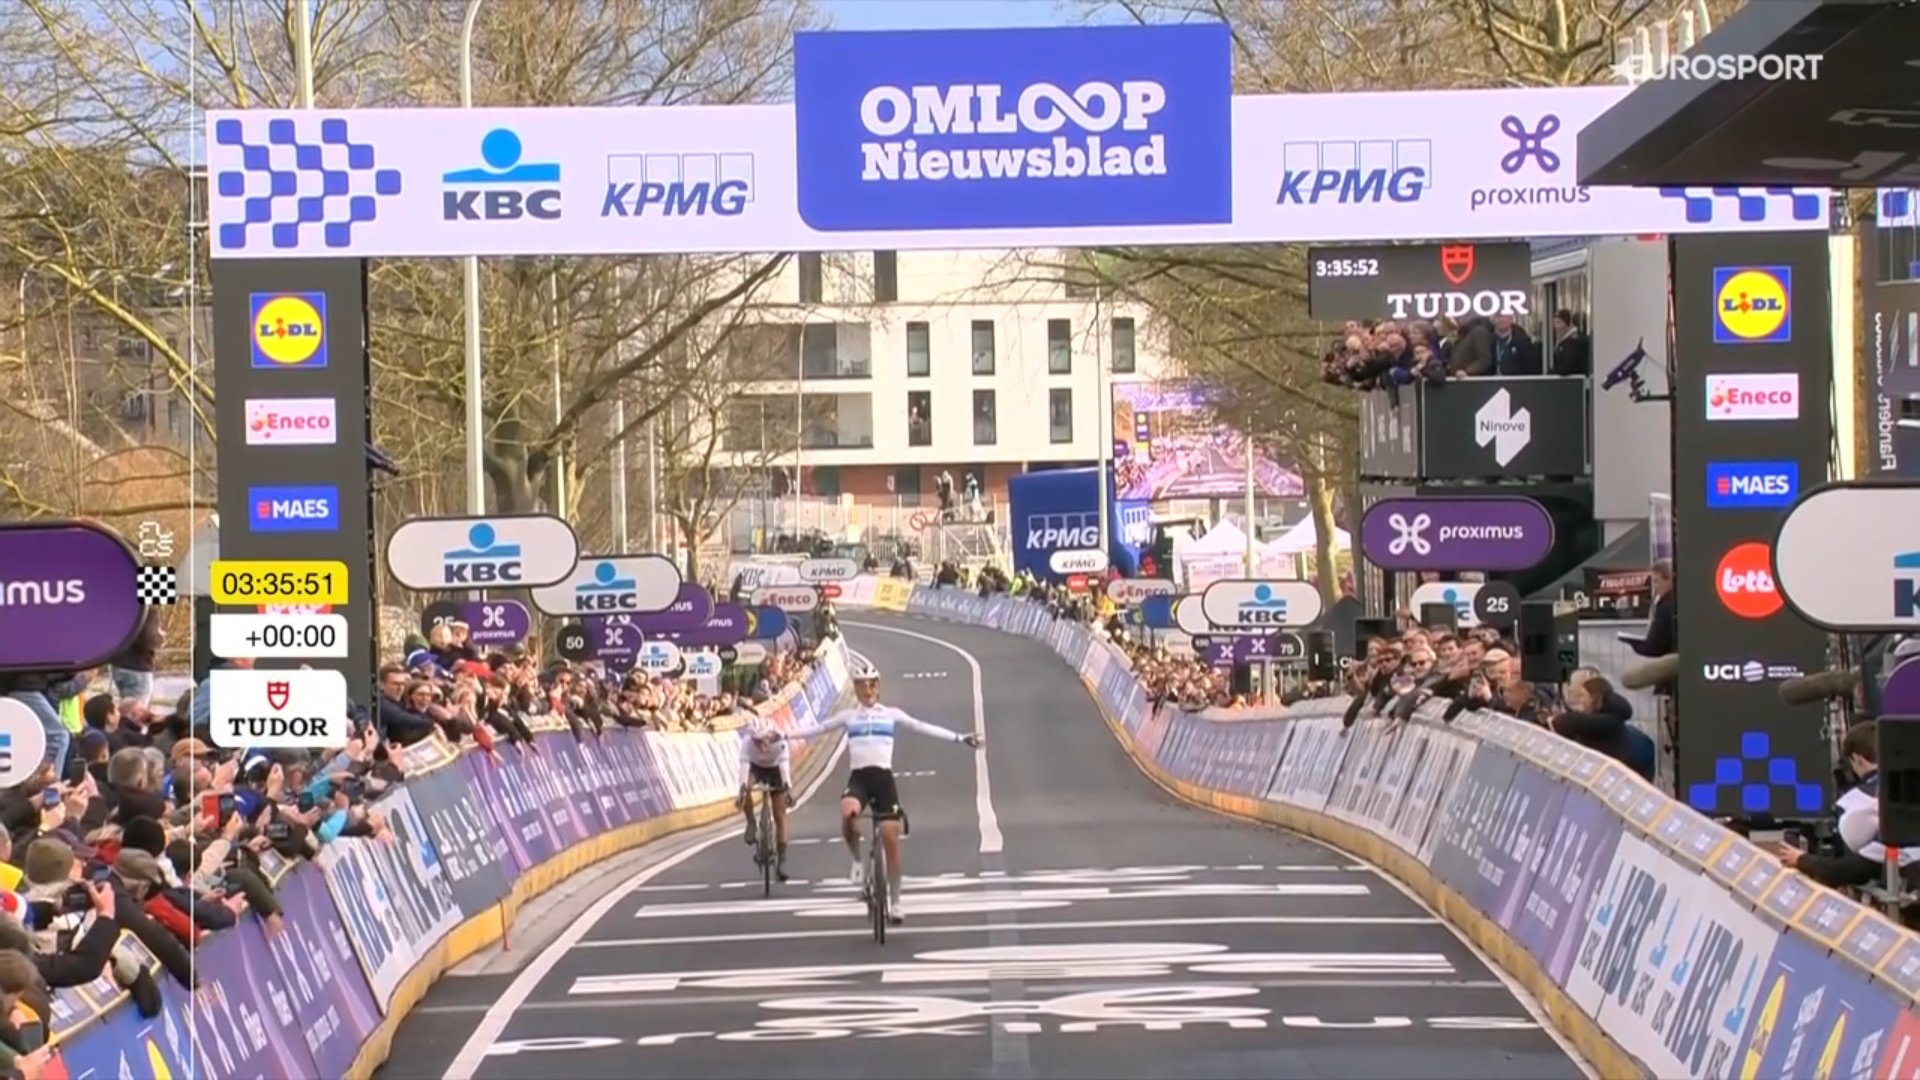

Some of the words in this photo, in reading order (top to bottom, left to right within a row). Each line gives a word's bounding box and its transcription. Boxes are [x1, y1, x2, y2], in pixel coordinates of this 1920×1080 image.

[860, 81, 1167, 136] OMLOOP
[861, 134, 1167, 181] Nieuwsblad
[1276, 167, 1426, 205] KPMG
[443, 189, 562, 221] KBC
[601, 179, 750, 217] KPMG
[1471, 185, 1591, 210] proximus
[1316, 260, 1379, 277] 3:35:52
[1387, 290, 1528, 319] TUDOR
[1728, 388, 1792, 405] Eneco
[267, 413, 331, 430] Eneco
[1480, 420, 1525, 432] Ninove
[1732, 475, 1789, 494] MAES
[272, 499, 329, 520] MAES
[1026, 526, 1099, 549] KPMG
[1439, 522, 1524, 543] proximus
[444, 562, 522, 583] KBC
[811, 567, 845, 577] KPMG
[576, 593, 637, 611] KBC
[770, 594, 810, 605] Eneco
[1486, 597, 1509, 613] 25
[1238, 610, 1287, 623] KBC
[473, 629, 516, 640] proximus
[566, 636, 584, 649] 50
[1281, 643, 1294, 655] 75
[1703, 664, 1741, 680] UCI
[1592, 865, 1667, 1007] KBC
[1664, 919, 1744, 1077] KBC
[485, 1016, 1538, 1055] proximus
